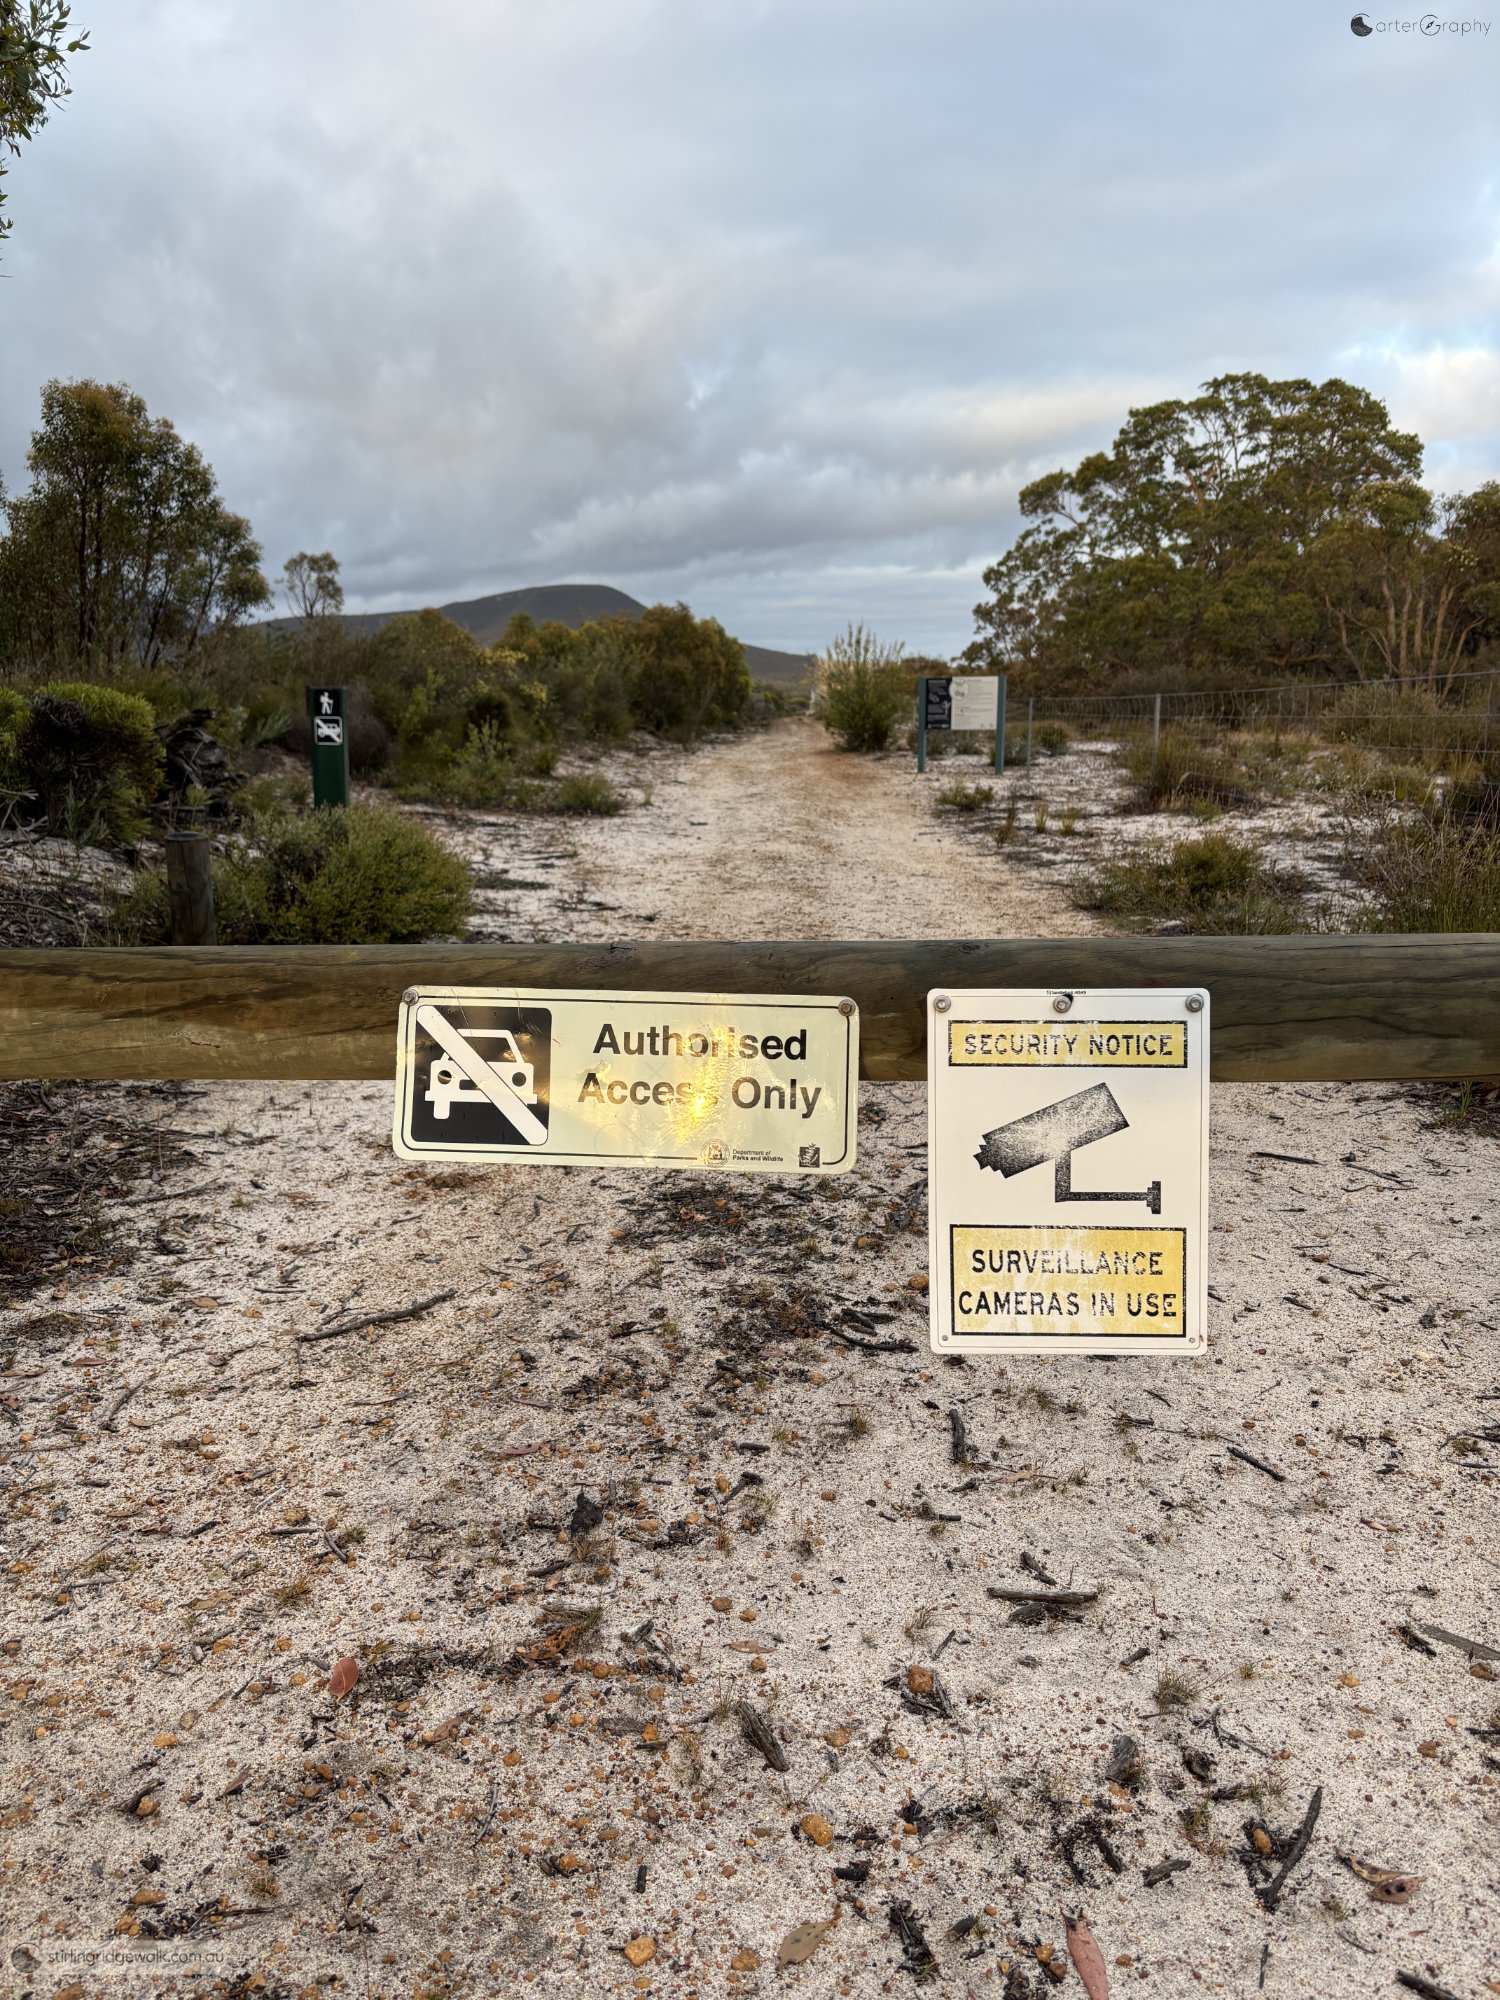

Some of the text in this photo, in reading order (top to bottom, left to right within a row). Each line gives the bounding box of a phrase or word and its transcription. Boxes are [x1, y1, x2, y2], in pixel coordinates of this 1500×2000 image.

[592, 1023, 807, 1060] Authorised
[964, 1033, 1173, 1056] SECURITY NOTICE
[577, 1072, 822, 1119] Acces Only
[732, 1148, 764, 1156] Department
[971, 1249, 1164, 1276] SURVEILLANCE
[958, 1290, 1177, 1317] CAMERAS IN USE
